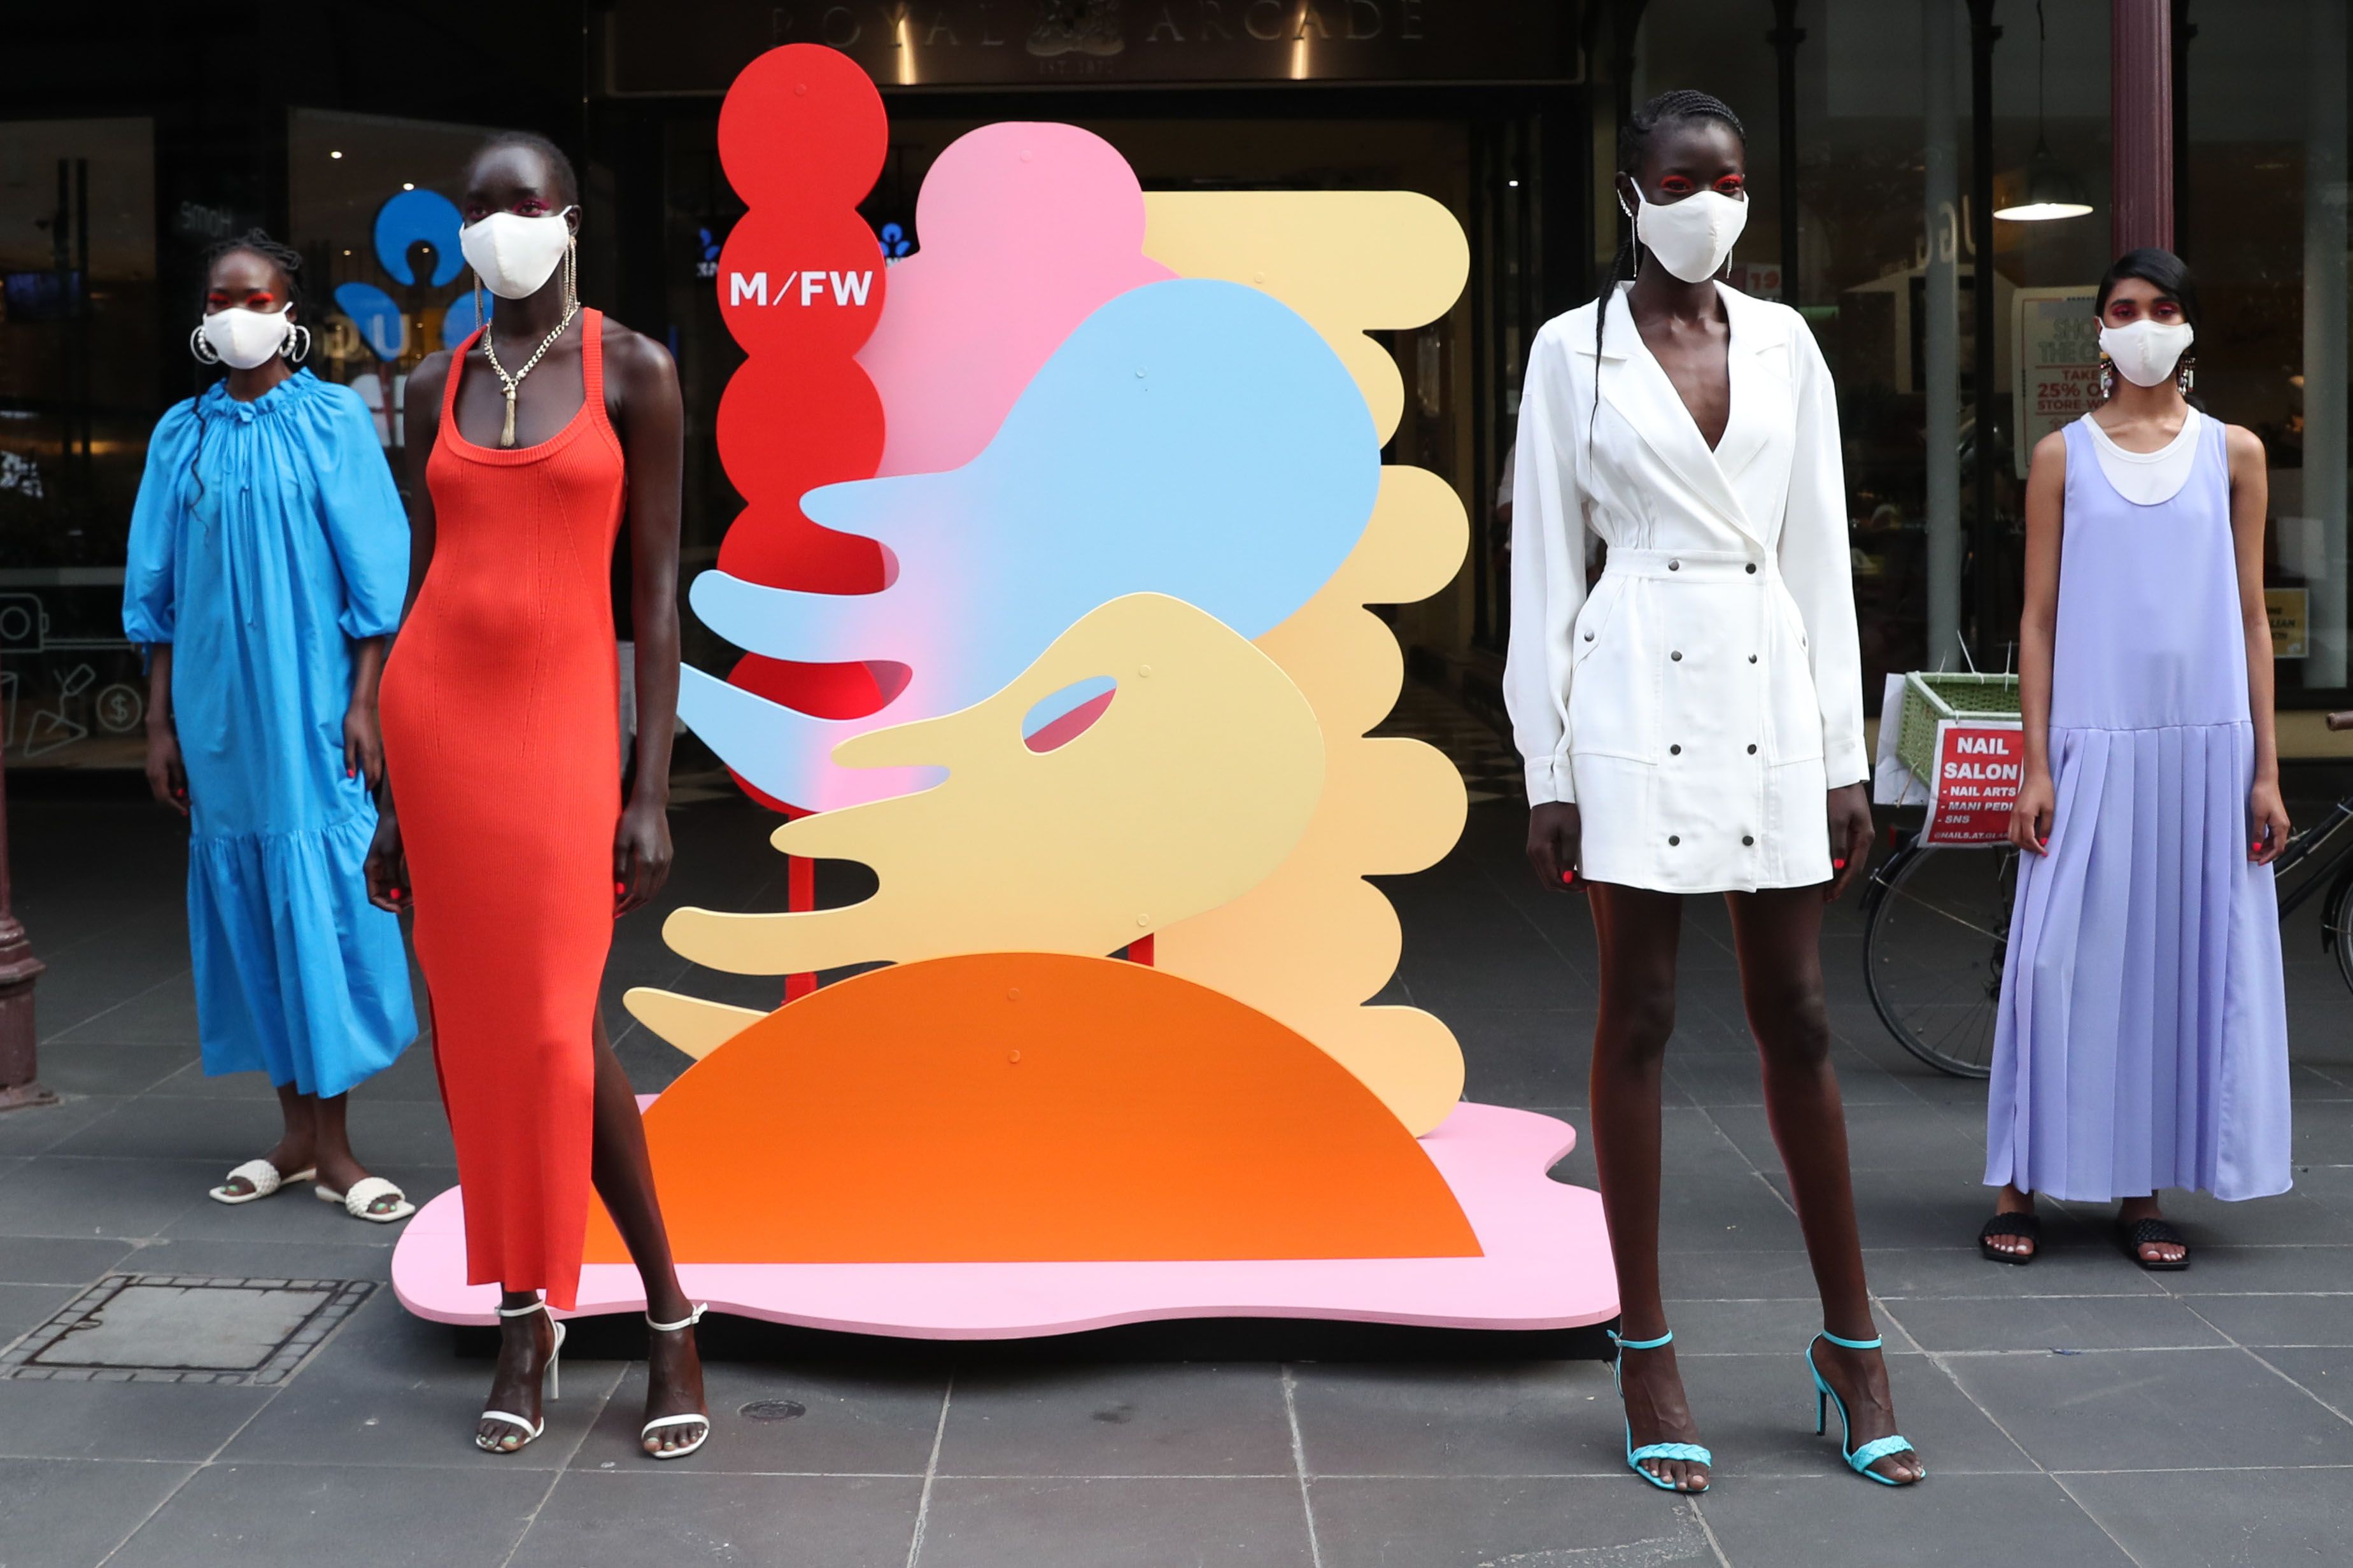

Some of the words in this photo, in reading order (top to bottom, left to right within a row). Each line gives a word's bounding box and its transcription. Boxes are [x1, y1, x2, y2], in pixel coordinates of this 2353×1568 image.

[730, 270, 873, 307] M/FW
[2053, 318, 2095, 340] SHO
[2038, 341, 2076, 362] THE
[2062, 371, 2099, 380] TAKE
[2037, 383, 2081, 397] 25%
[2087, 383, 2102, 397] O
[1957, 737, 2009, 755] NAIL
[1944, 762, 2017, 780] SALON
[1950, 787, 1980, 796] NAIL
[1982, 788, 2016, 797] ARTS
[1948, 802, 1981, 810] MANI
[1945, 816, 1970, 824] SNS
